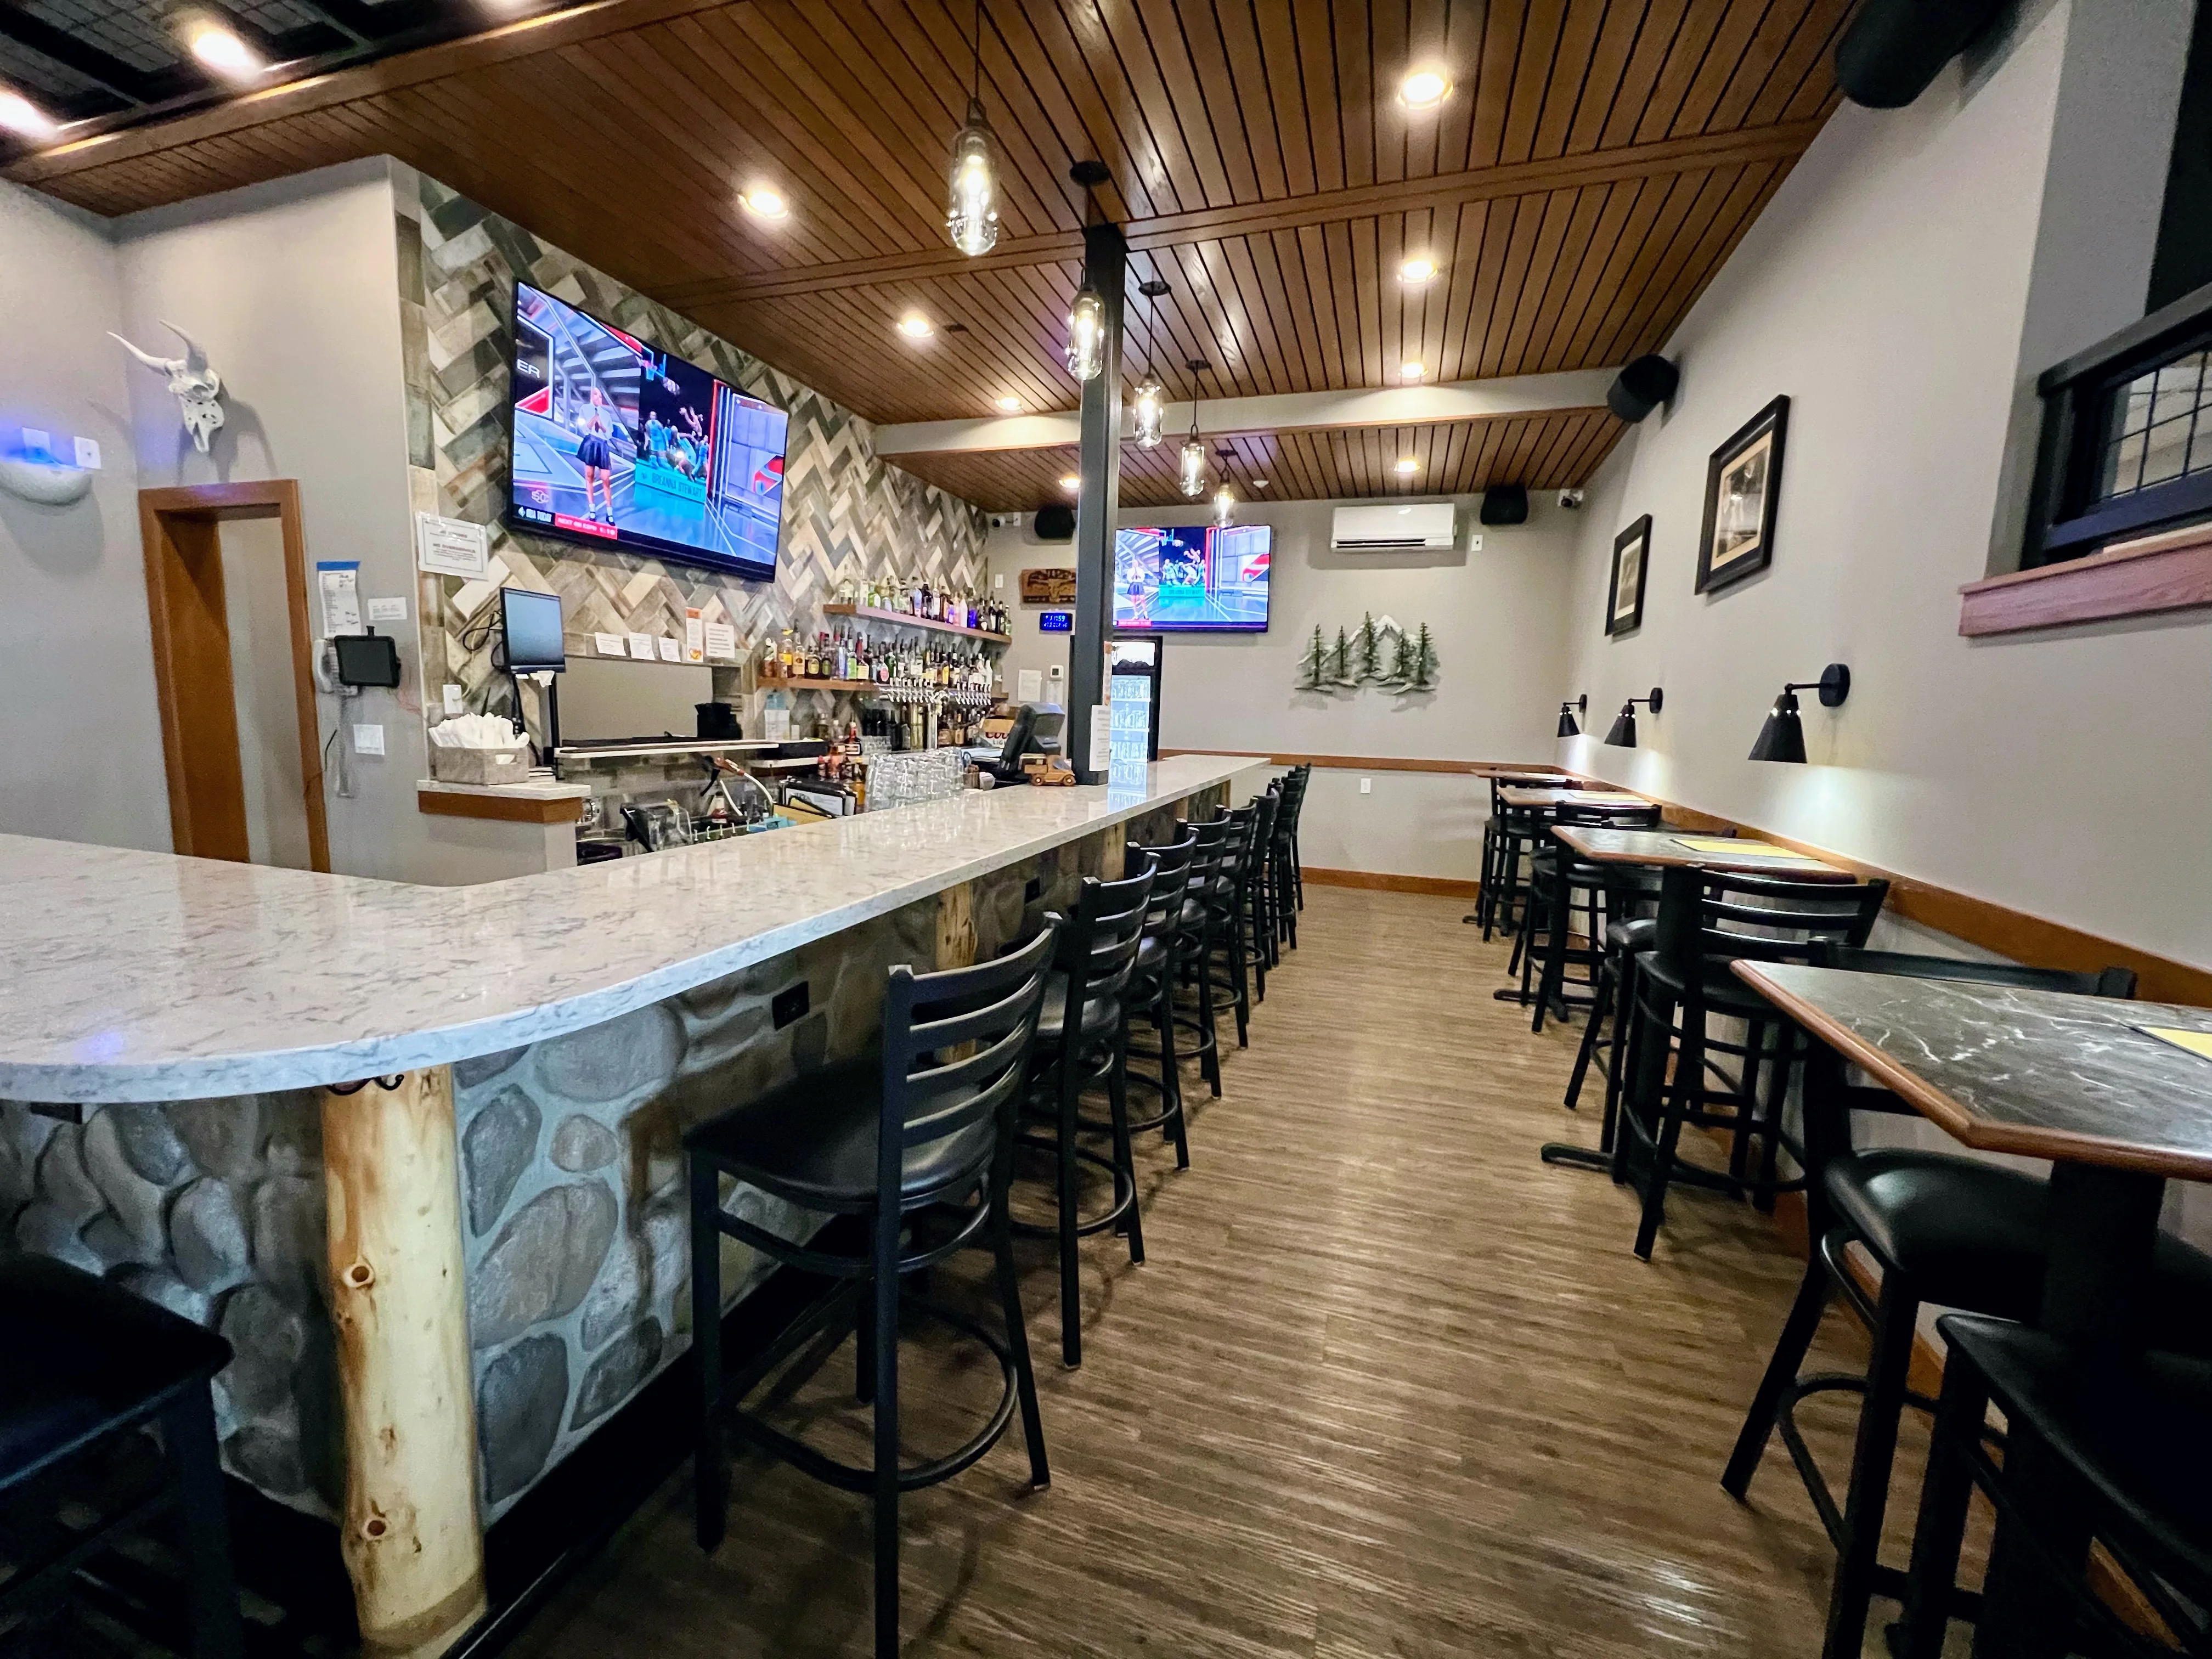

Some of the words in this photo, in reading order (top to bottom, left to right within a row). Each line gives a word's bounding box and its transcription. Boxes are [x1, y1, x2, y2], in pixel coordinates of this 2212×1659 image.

[517, 359, 540, 378] ER
[652, 472, 676, 489] BREANNA
[678, 482, 703, 499] STEWART
